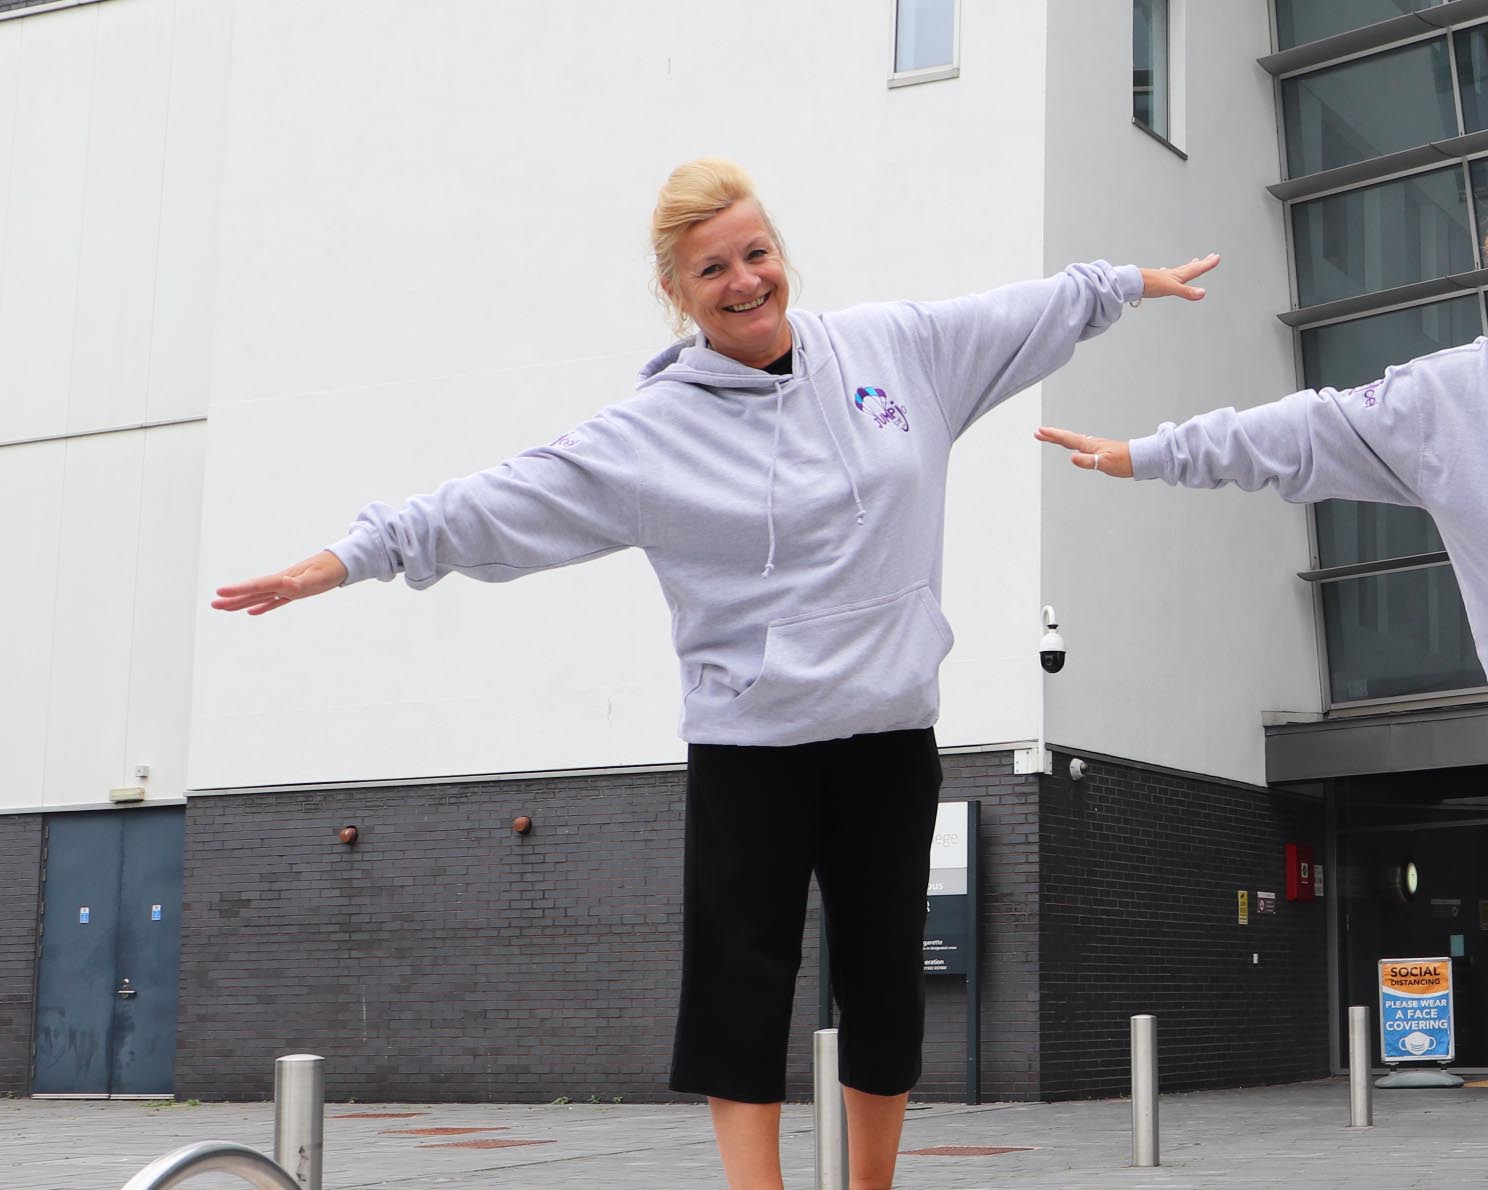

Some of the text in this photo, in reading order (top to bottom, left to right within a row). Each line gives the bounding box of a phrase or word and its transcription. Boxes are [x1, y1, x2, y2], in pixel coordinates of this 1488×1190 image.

[1390, 966, 1440, 978] SOCIAL
[1390, 978, 1441, 986] DISTANCING
[1385, 999, 1447, 1008] PLEASE WEAR
[1395, 1009, 1438, 1019] A FACE
[1385, 1020, 1448, 1031] COVERING
